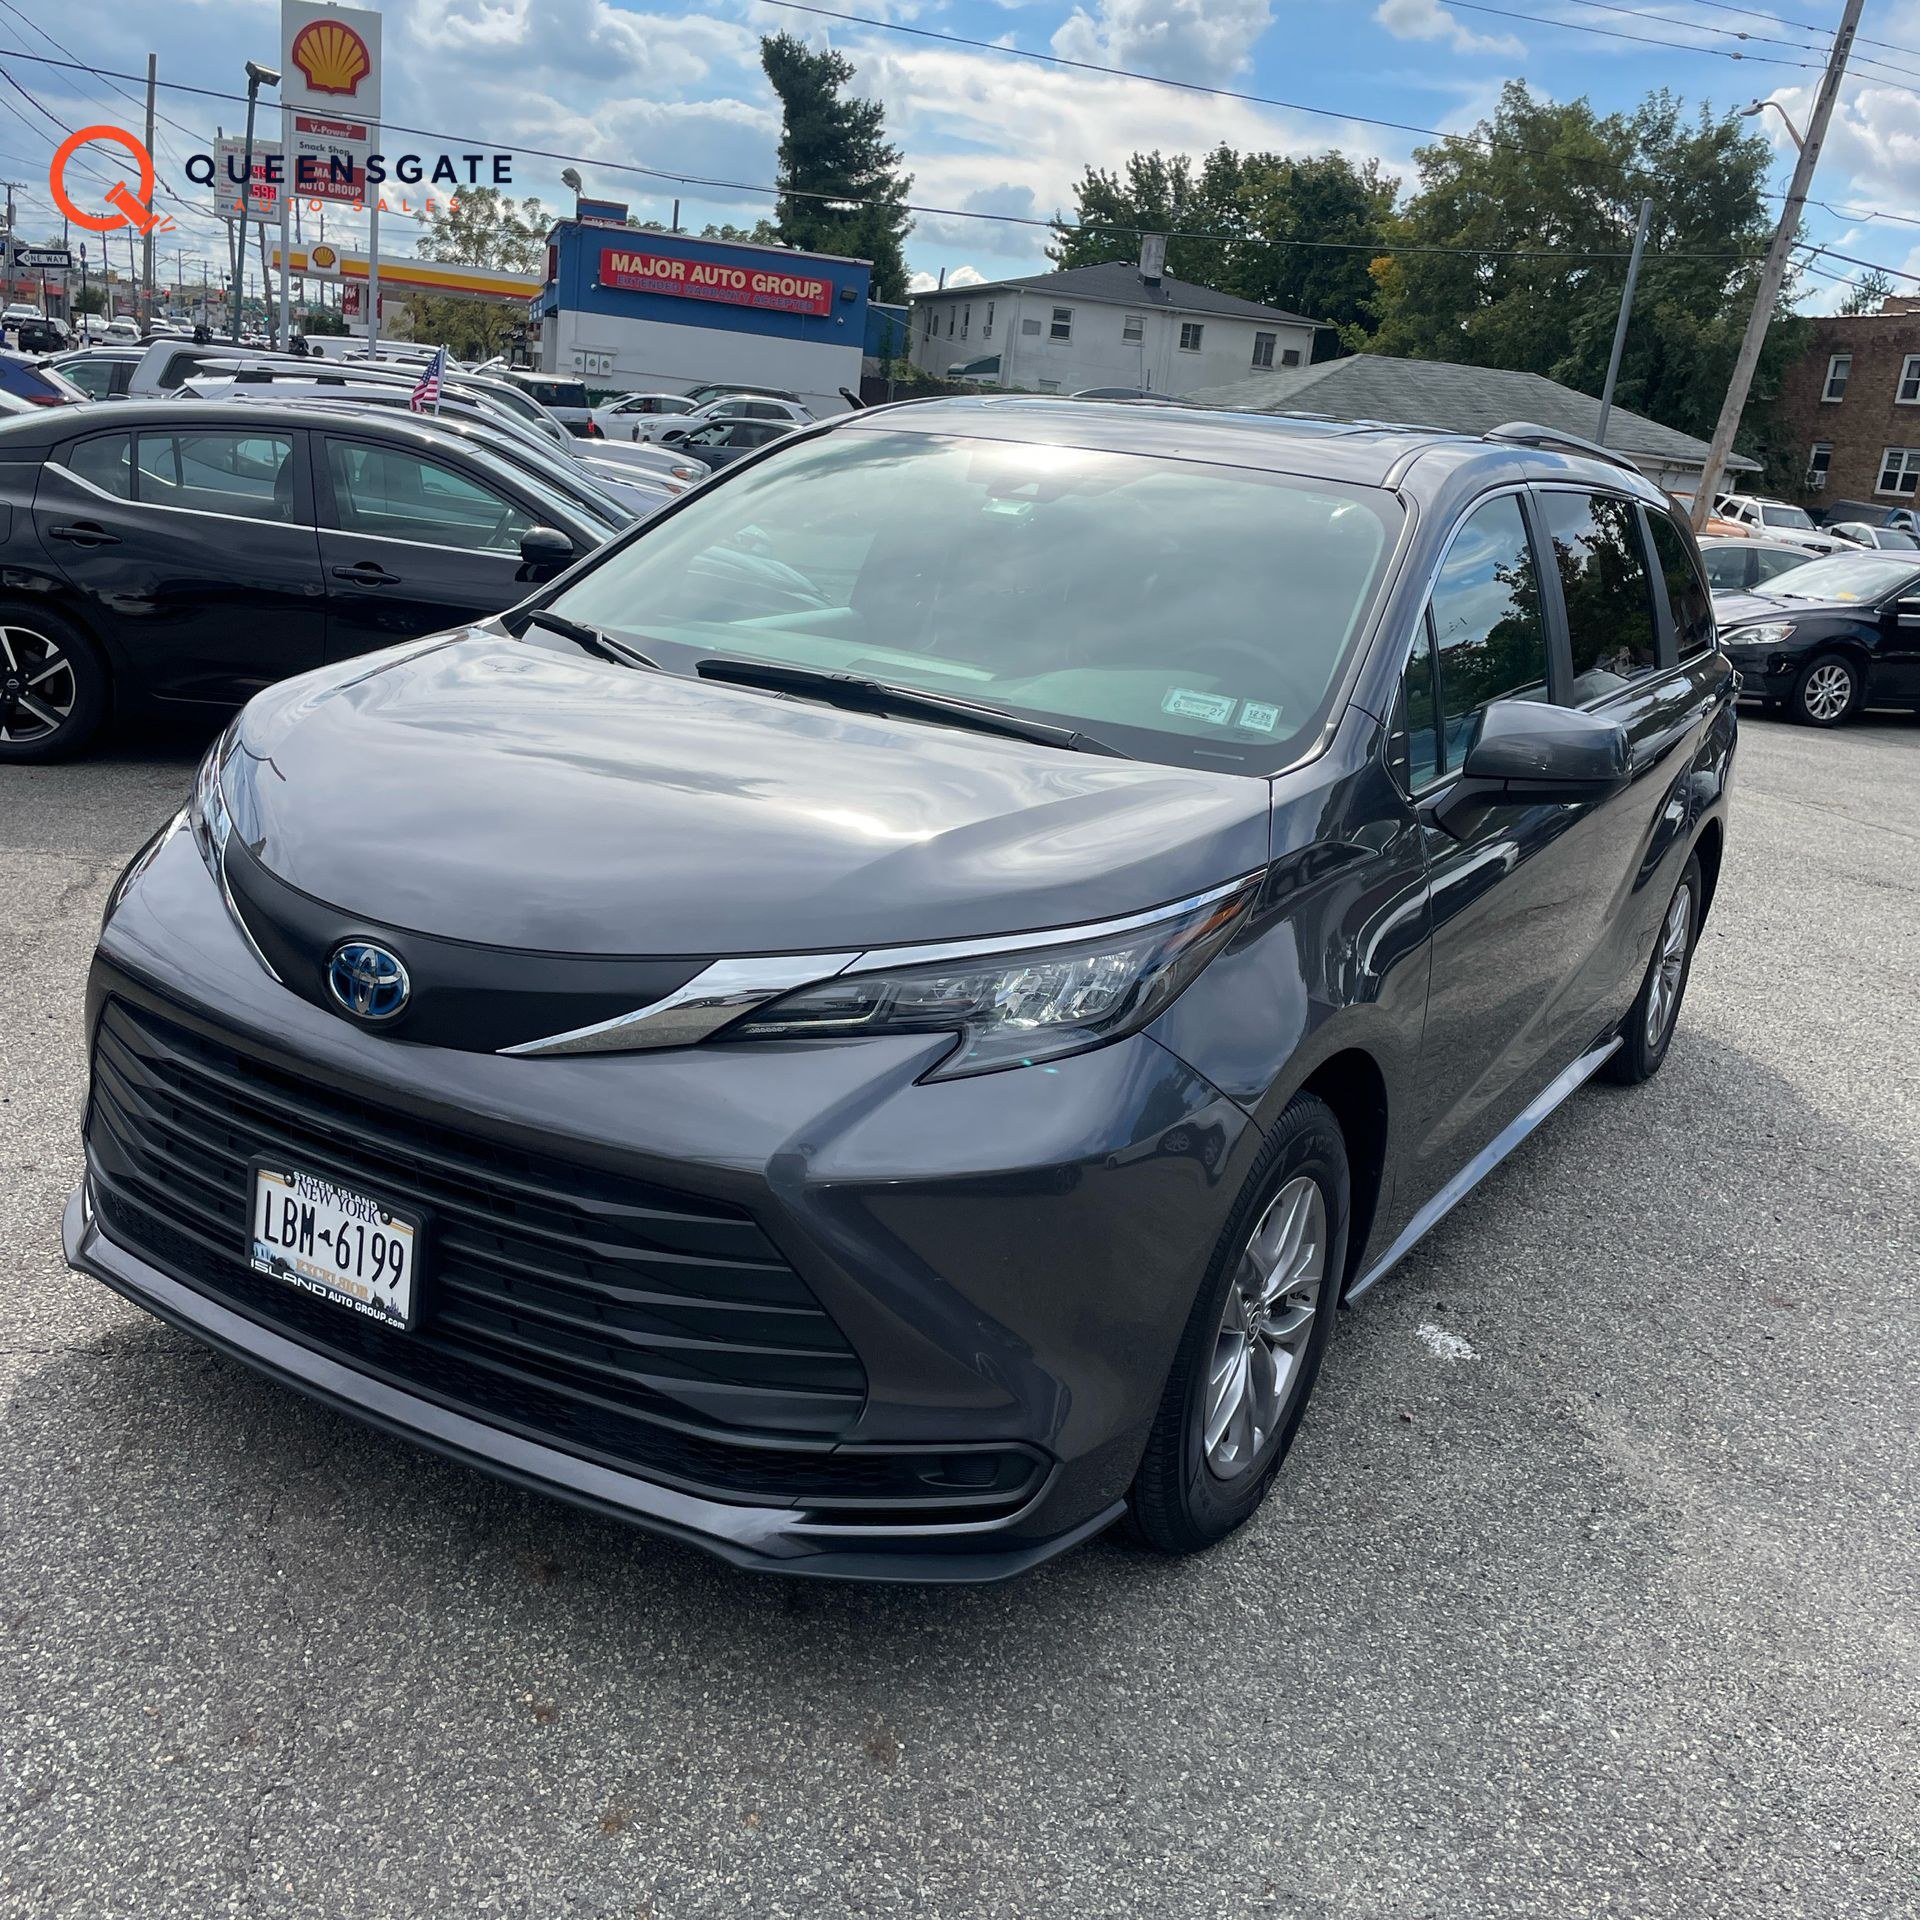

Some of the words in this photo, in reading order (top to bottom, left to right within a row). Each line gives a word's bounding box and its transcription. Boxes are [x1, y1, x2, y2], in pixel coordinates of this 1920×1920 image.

[310, 124, 350, 137] V-Power
[299, 141, 325, 152] Snack
[328, 145, 350, 157] Shop
[300, 181, 325, 193] AUTO
[328, 183, 361, 196] GROUP
[24, 254, 41, 262] ONE
[46, 255, 64, 263] WAY
[611, 253, 686, 281] MAJOR
[690, 265, 747, 289] AUTO
[617, 274, 680, 292] EXTENDED
[684, 284, 751, 303] WARRANTY
[753, 294, 814, 311] ACCEPTED
[1209, 707, 1225, 717] 27
[293, 1171, 334, 1194] STATEN
[337, 1187, 378, 1210] ISLAND
[297, 1182, 333, 1207] NEW
[338, 1195, 379, 1226] YORK
[250, 1258, 327, 1297] ISLAND
[328, 1290, 353, 1309] AUTO
[355, 1301, 406, 1331] GROUP.com
